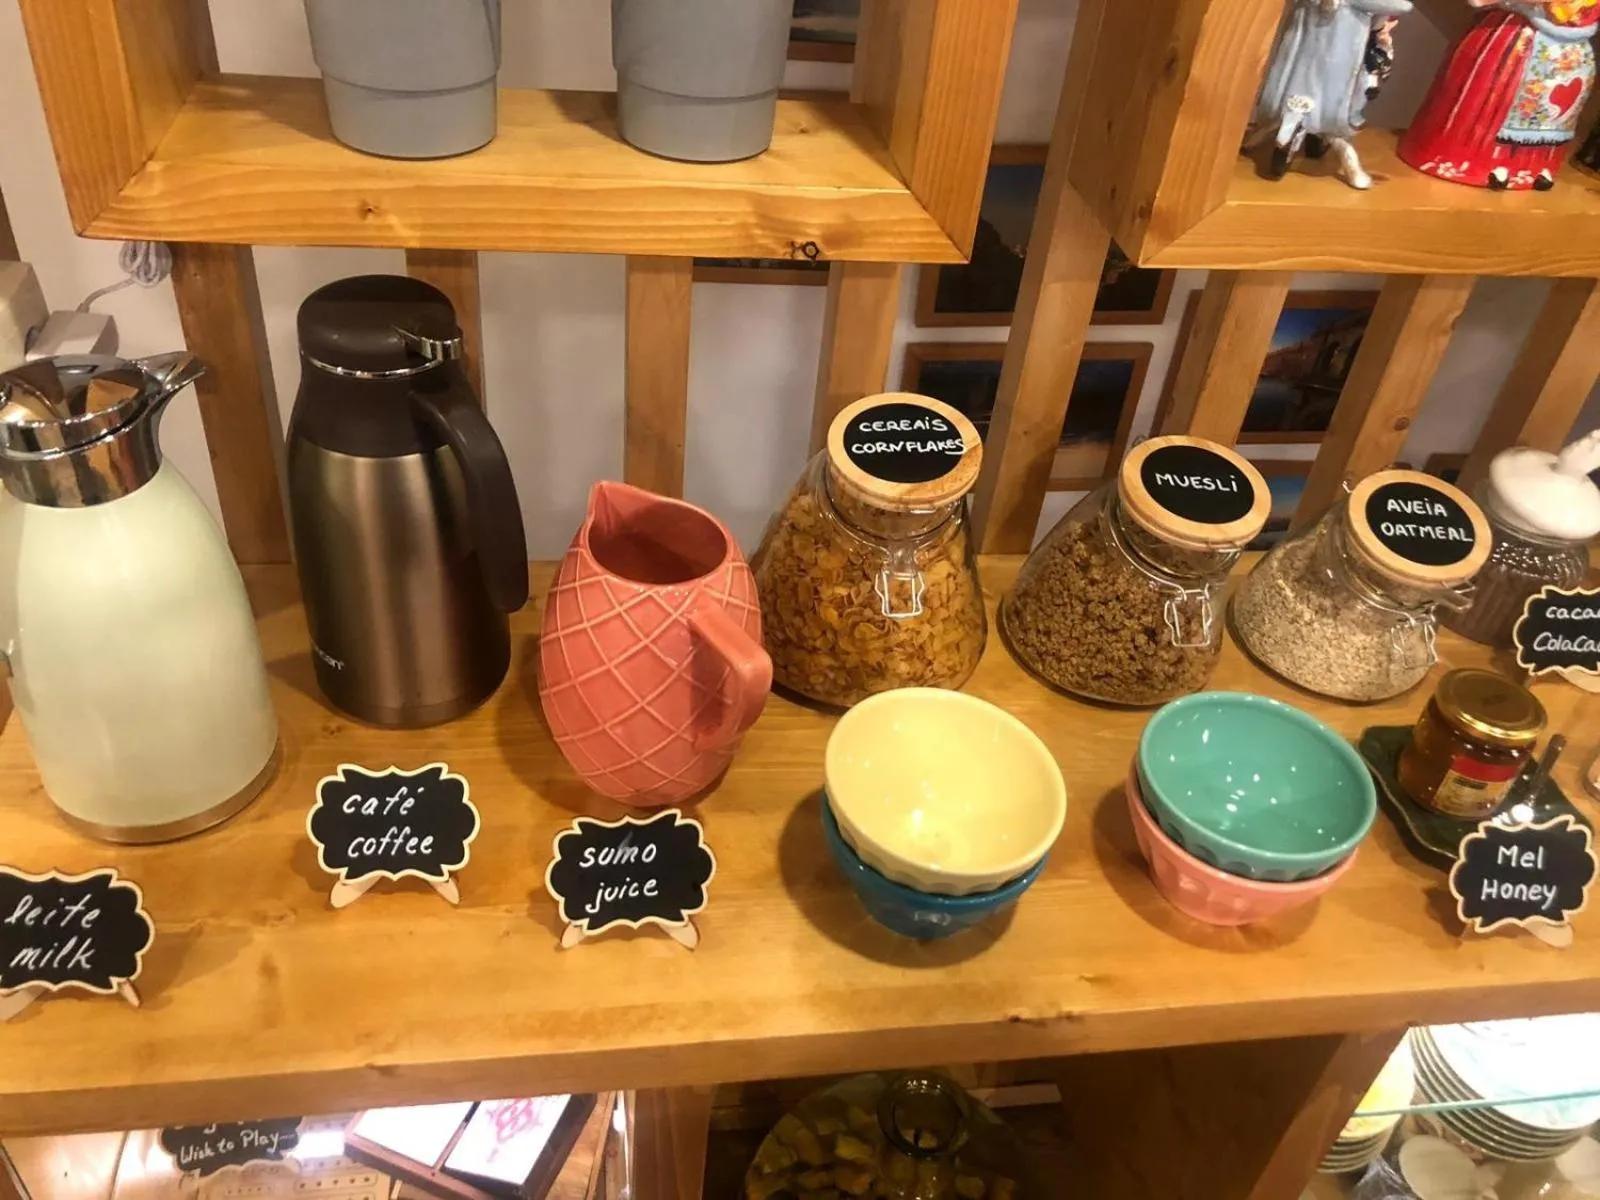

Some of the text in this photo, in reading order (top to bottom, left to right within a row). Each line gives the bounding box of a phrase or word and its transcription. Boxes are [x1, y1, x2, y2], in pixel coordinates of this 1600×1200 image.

[1380, 521, 1475, 543] OATMEAL
[1545, 605, 1600, 620] caca
[342, 785, 426, 816] café
[347, 825, 435, 858] coffee
[578, 842, 658, 869] sumo
[1496, 844, 1546, 870] Mel
[585, 876, 660, 914] juice
[1480, 877, 1558, 912] Honey
[3, 893, 102, 929] leite
[9, 935, 96, 970] milk
[217, 1138, 235, 1153] to
